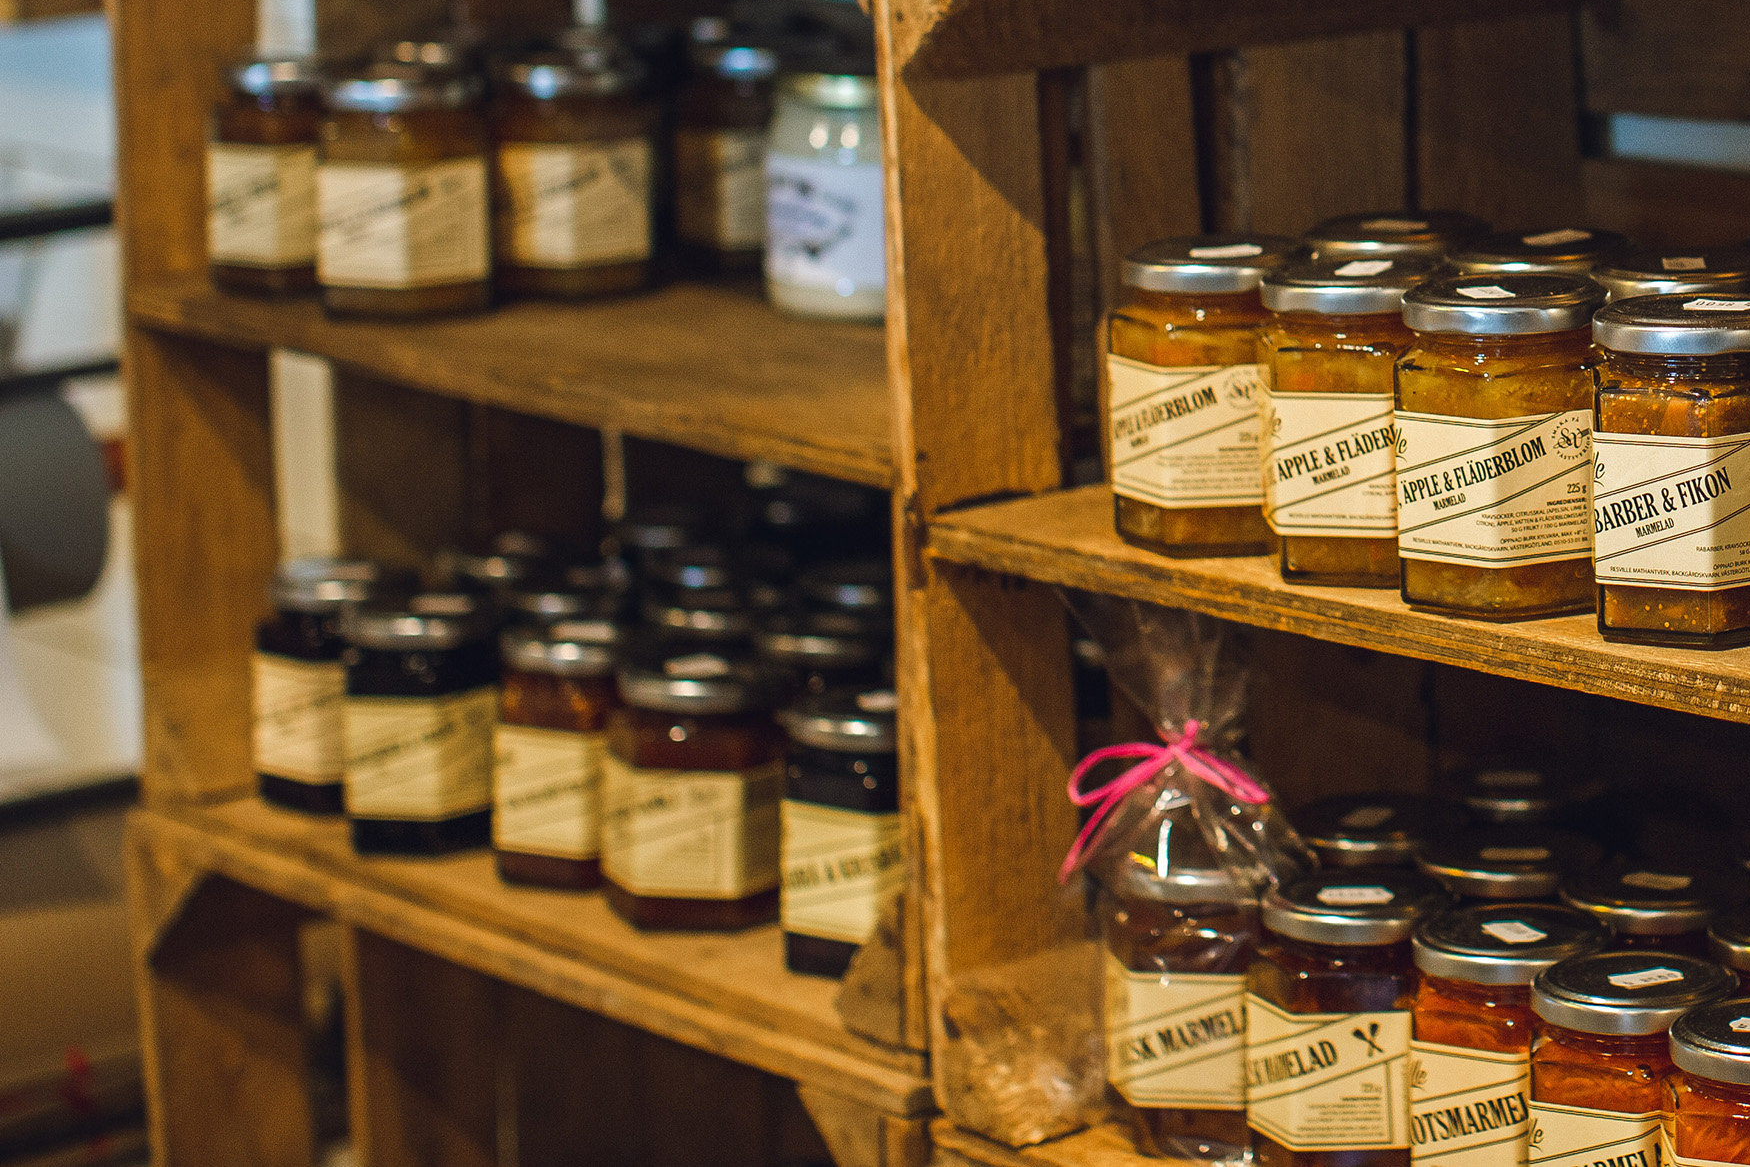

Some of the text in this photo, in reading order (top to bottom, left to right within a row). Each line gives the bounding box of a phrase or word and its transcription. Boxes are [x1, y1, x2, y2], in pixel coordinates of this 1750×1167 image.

[1277, 449, 1322, 482] ÄPPLE
[1323, 446, 1337, 466] &
[1400, 436, 1547, 505] ÄPPLE & FLÄDERBLOM
[1433, 493, 1466, 511] MARMELAD
[1566, 482, 1581, 494] 225
[1594, 466, 1732, 534] BARBER & FIKON
[1635, 517, 1675, 538] MARMELAD
